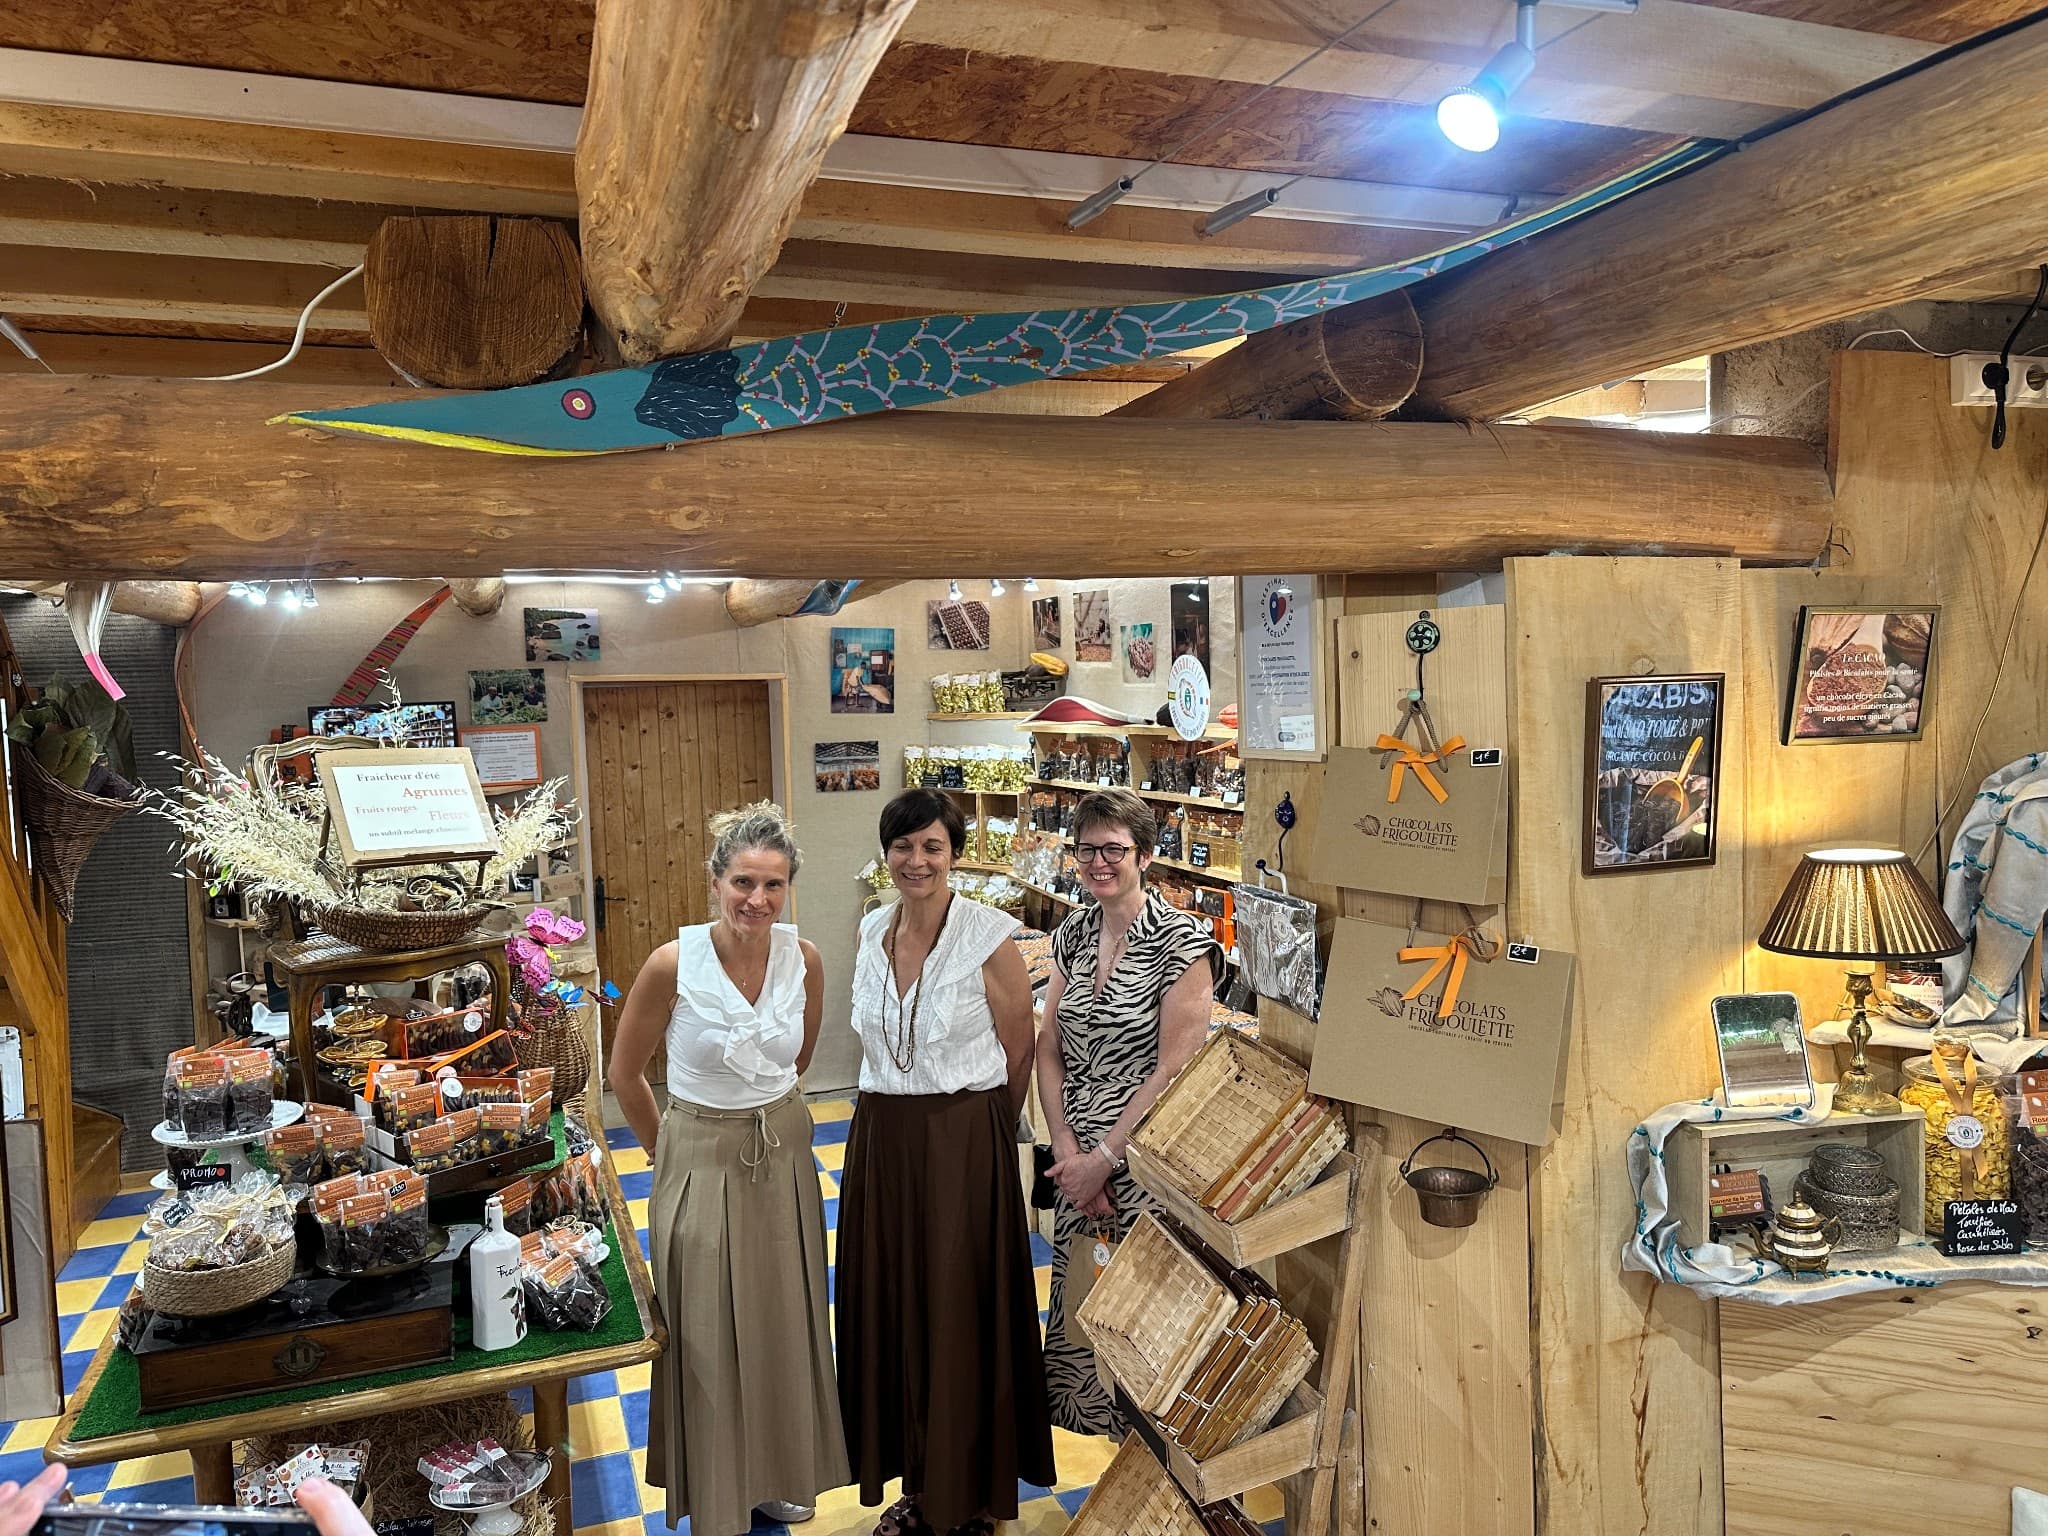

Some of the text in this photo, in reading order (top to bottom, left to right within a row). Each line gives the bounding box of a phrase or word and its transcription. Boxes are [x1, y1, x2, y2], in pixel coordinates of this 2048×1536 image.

[1842, 652, 1886, 663] Le CACAO
[1874, 670, 1890, 679] pour
[1826, 692, 1855, 700] chocolat
[1829, 704, 1850, 713] moins
[1861, 702, 1889, 710] matières
[1889, 702, 1912, 711] grasses
[1823, 713, 1891, 724] peu de sucres ajoutés
[1605, 750, 1639, 762] ORGANIC
[1642, 750, 1676, 762] COCOA
[414, 771, 440, 781] d'été
[402, 787, 468, 800] Agrumes
[354, 804, 418, 815] Fruits rouges
[428, 809, 469, 822] Fleurs
[1388, 816, 1453, 834] CHOCOLATS
[380, 828, 402, 838] subtil
[1381, 827, 1459, 847] FRIGOULETTE
[1511, 946, 1528, 956] 2€
[1417, 992, 1507, 1021] CHCOLATS
[1409, 1006, 1516, 1040] FRIGOULETTE
[180, 1166, 217, 1181] PROMO
[1948, 1201, 1985, 1216] Pétales
[1986, 1200, 1998, 1214] de
[1956, 1242, 1977, 1254] Rose
[1977, 1240, 1990, 1251] des
[1990, 1237, 2014, 1251] Sables
